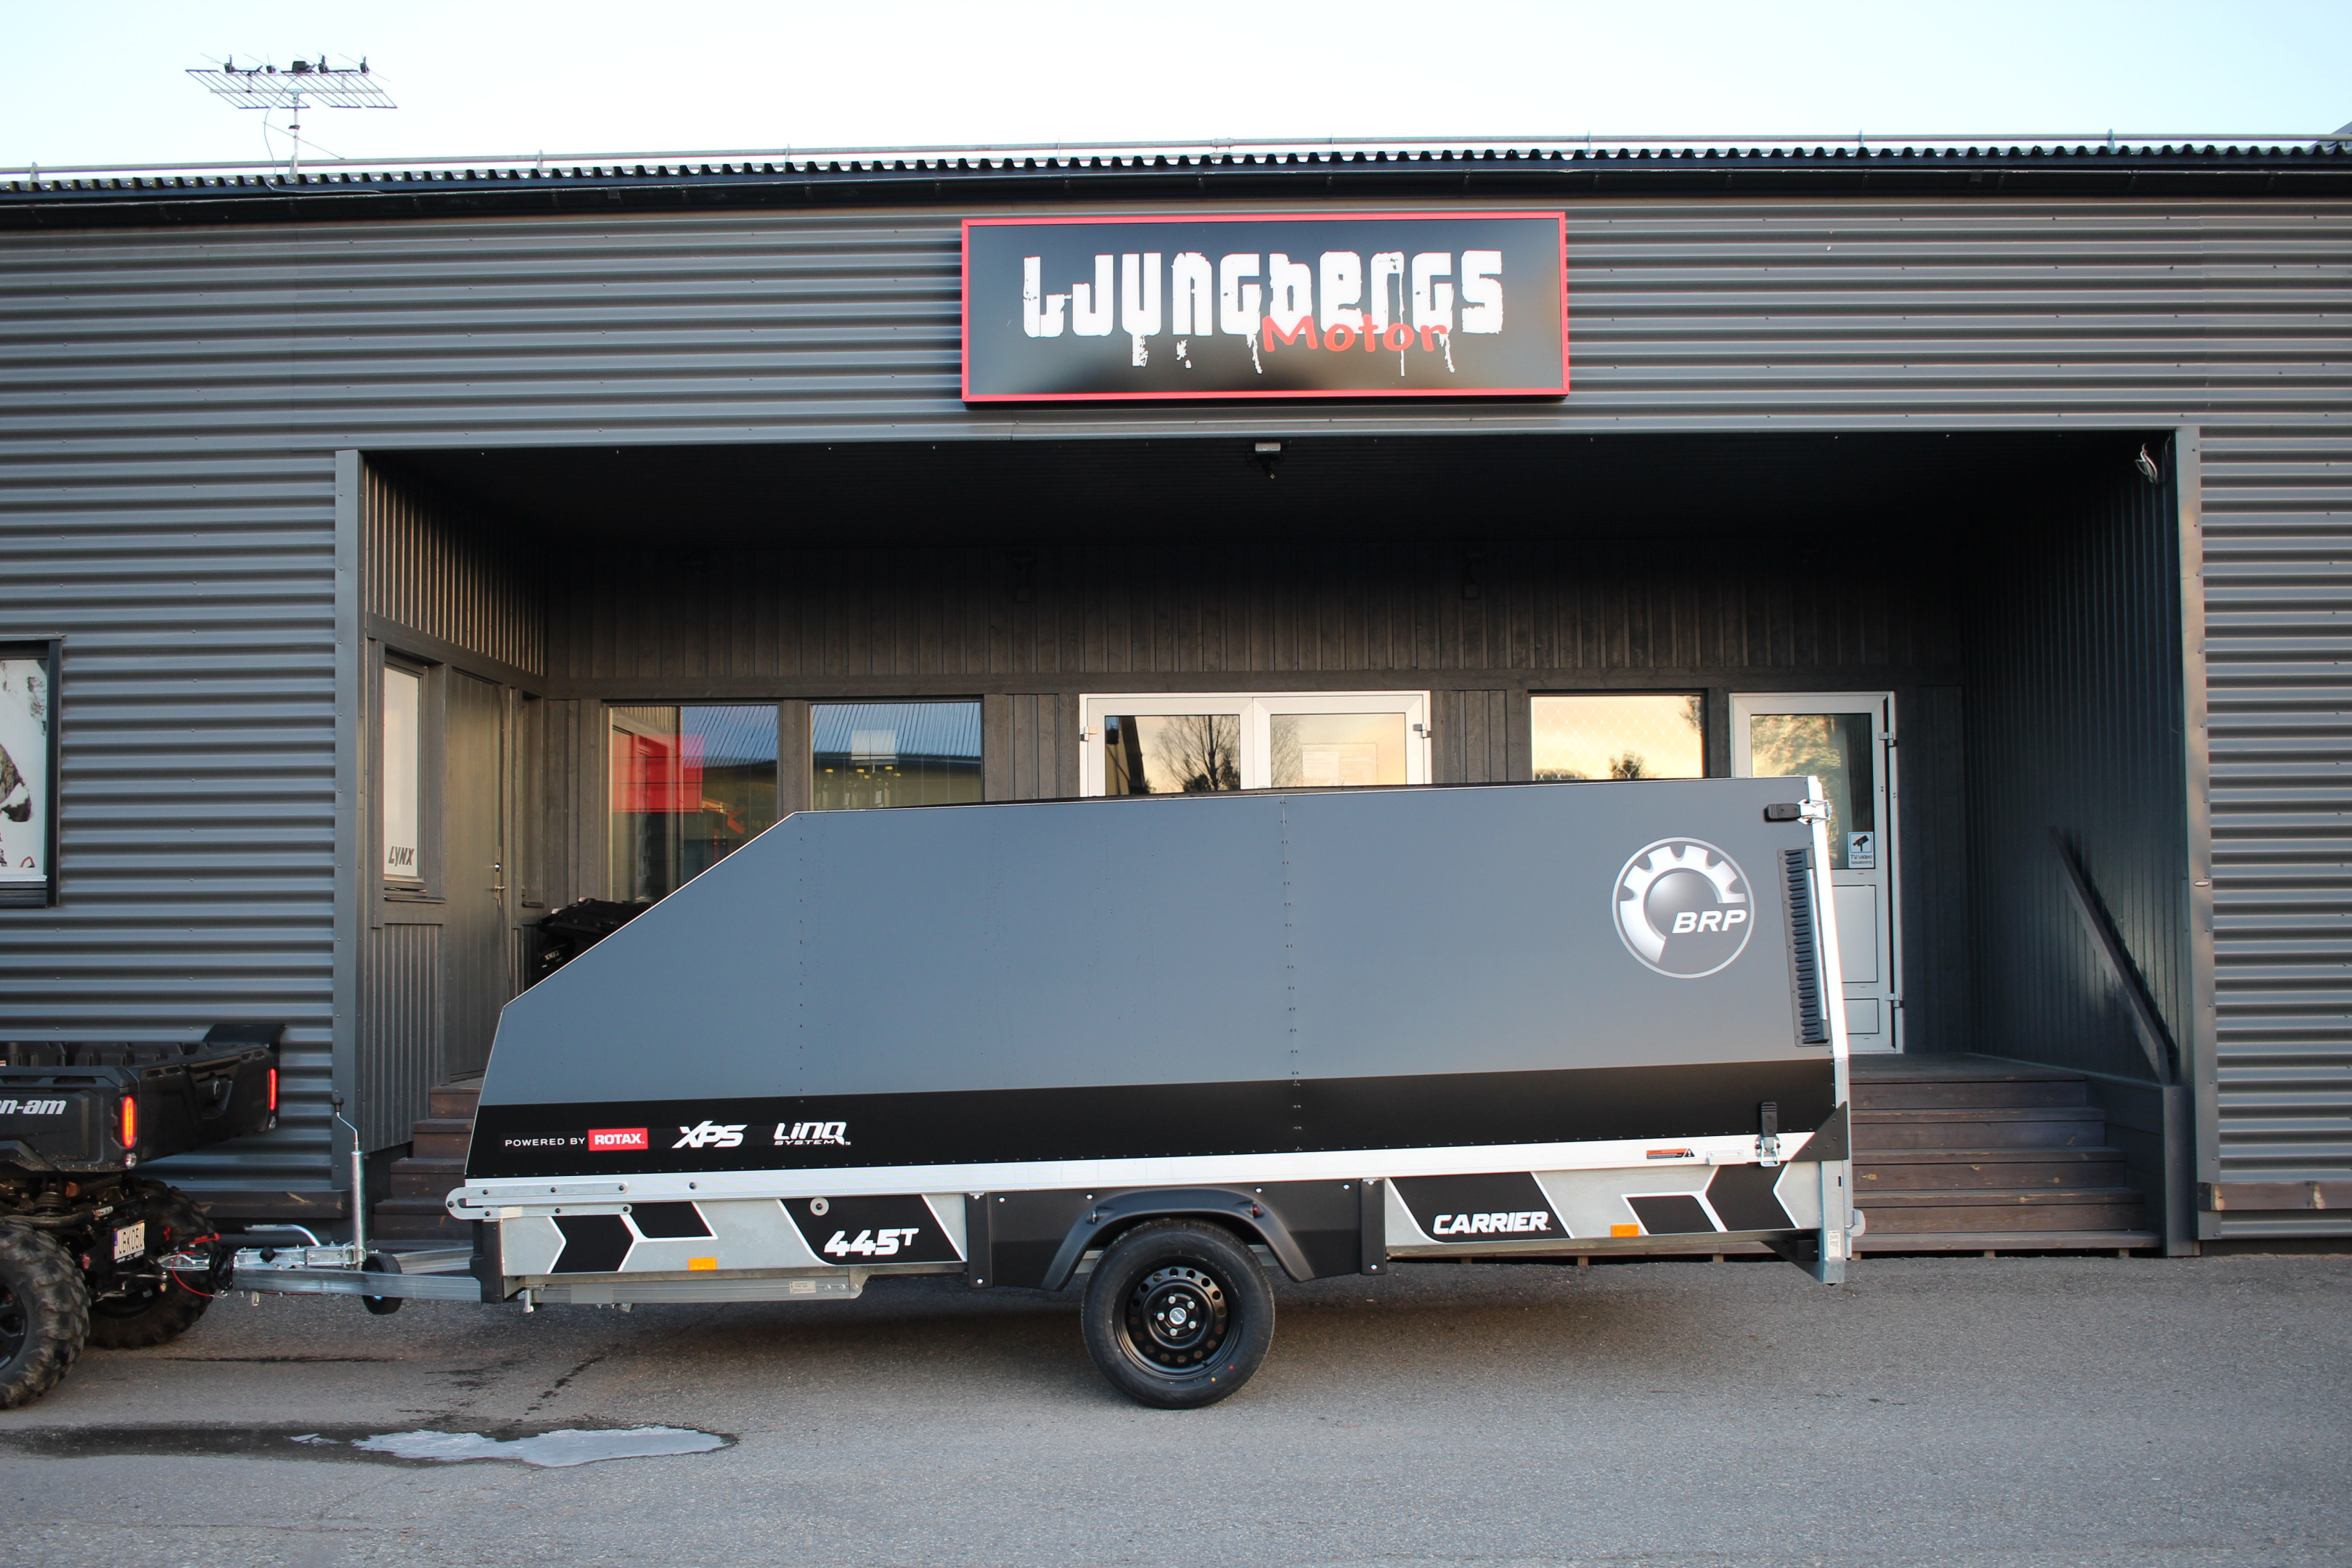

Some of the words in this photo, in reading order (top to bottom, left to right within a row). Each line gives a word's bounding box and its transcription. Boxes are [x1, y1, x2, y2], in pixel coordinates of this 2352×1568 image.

[1262, 314, 1449, 353] Motor
[388, 846, 415, 867] LYNX
[1672, 910, 1747, 934] BRP
[0, 1100, 67, 1114] n-am
[505, 1138, 565, 1147] POWERED
[671, 1120, 748, 1148] XPS
[1433, 1211, 1549, 1235] CARRIER
[824, 1228, 920, 1257] 445T
